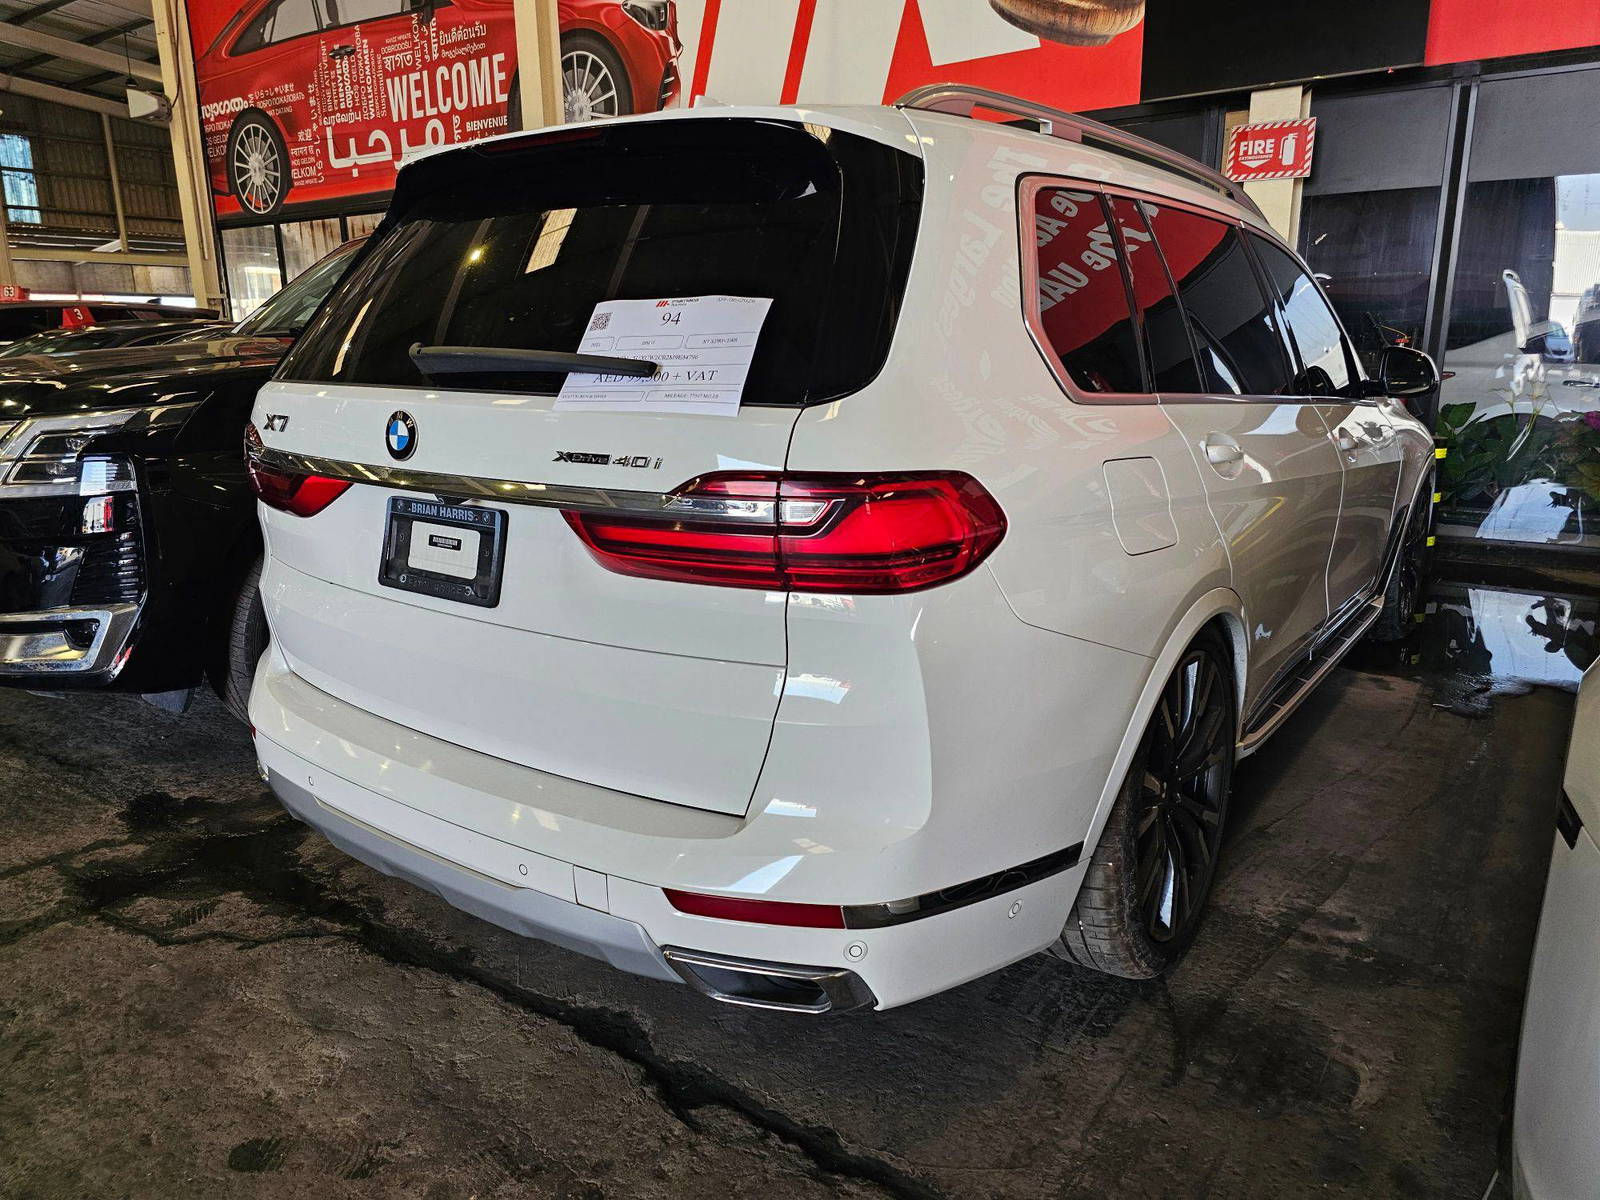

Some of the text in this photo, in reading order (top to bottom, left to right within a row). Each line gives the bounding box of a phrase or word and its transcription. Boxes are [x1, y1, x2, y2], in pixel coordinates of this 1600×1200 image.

[411, 13, 422, 70] WELKOM
[354, 25, 365, 84] ПОЖАЛОВА
[362, 39, 375, 119] WILLKOMMEN
[386, 53, 508, 123] WELCOME
[466, 115, 508, 132] BIENVENUE
[326, 118, 447, 178] مرحبا
[1239, 138, 1275, 156] FIRE
[3, 286, 15, 297] 63
[73, 308, 84, 320] 3
[660, 311, 682, 327] 94
[686, 370, 719, 381] VAT
[263, 413, 289, 432] X7
[411, 502, 475, 522] BRIAN HARRIS
